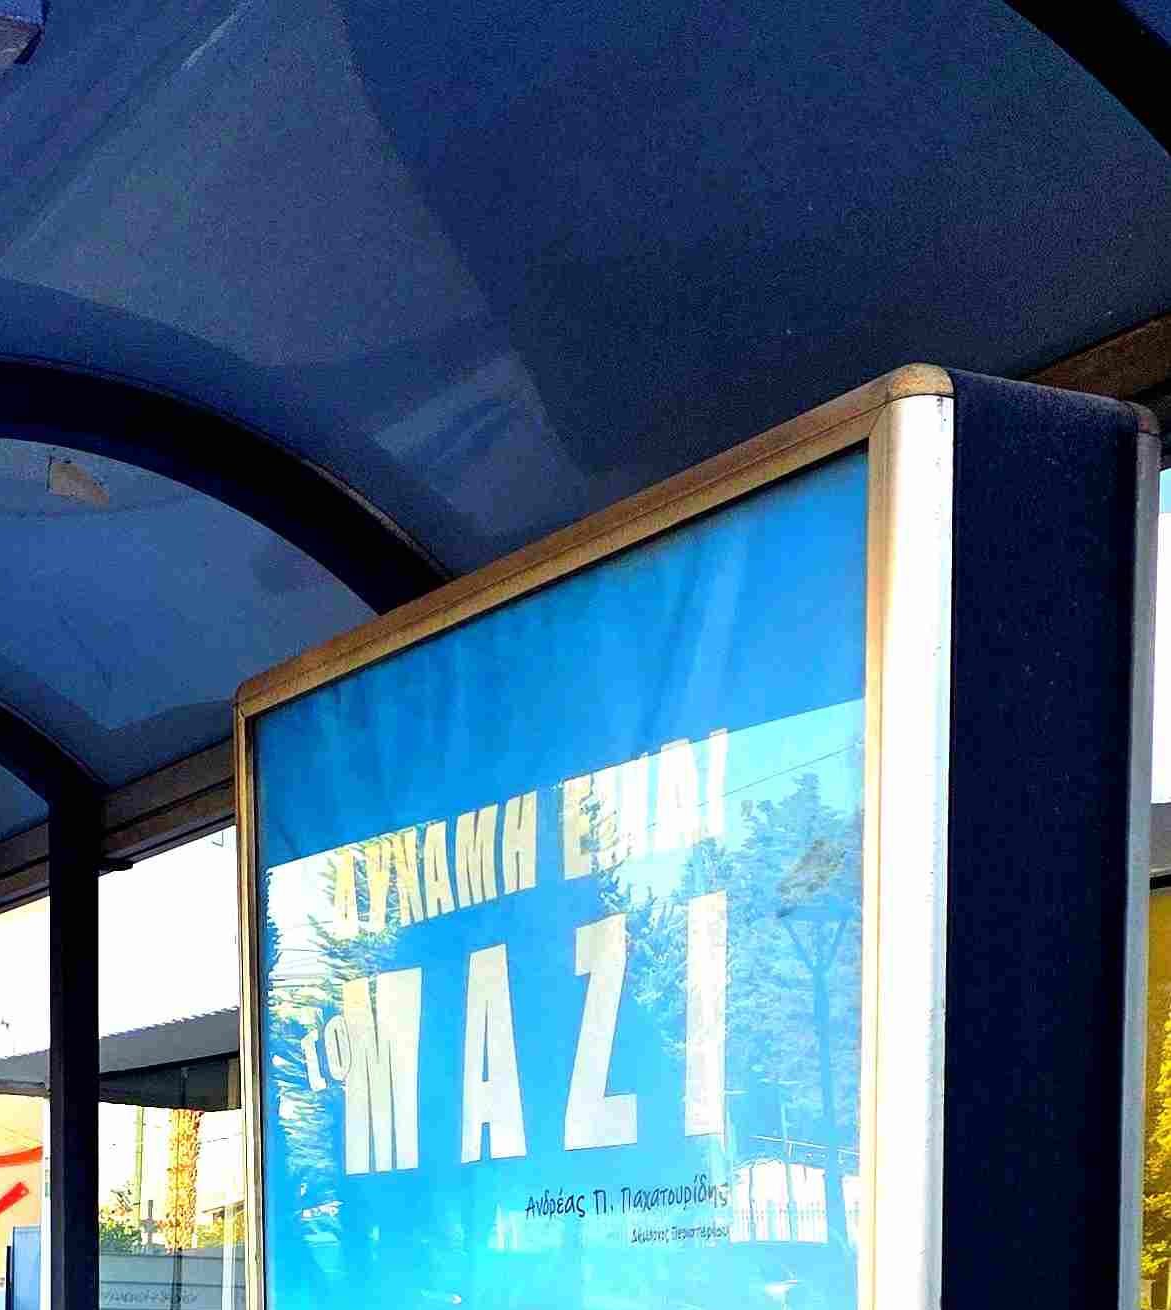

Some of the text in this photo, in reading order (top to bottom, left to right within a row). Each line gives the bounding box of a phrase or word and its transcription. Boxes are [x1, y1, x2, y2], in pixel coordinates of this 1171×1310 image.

[329, 791, 538, 938] ΔΥΝΑΜΗ
[344, 890, 728, 1175] ΜΑΖΙ
[525, 1174, 729, 1219] Ανδρέας Π. Παχατουρίδης
